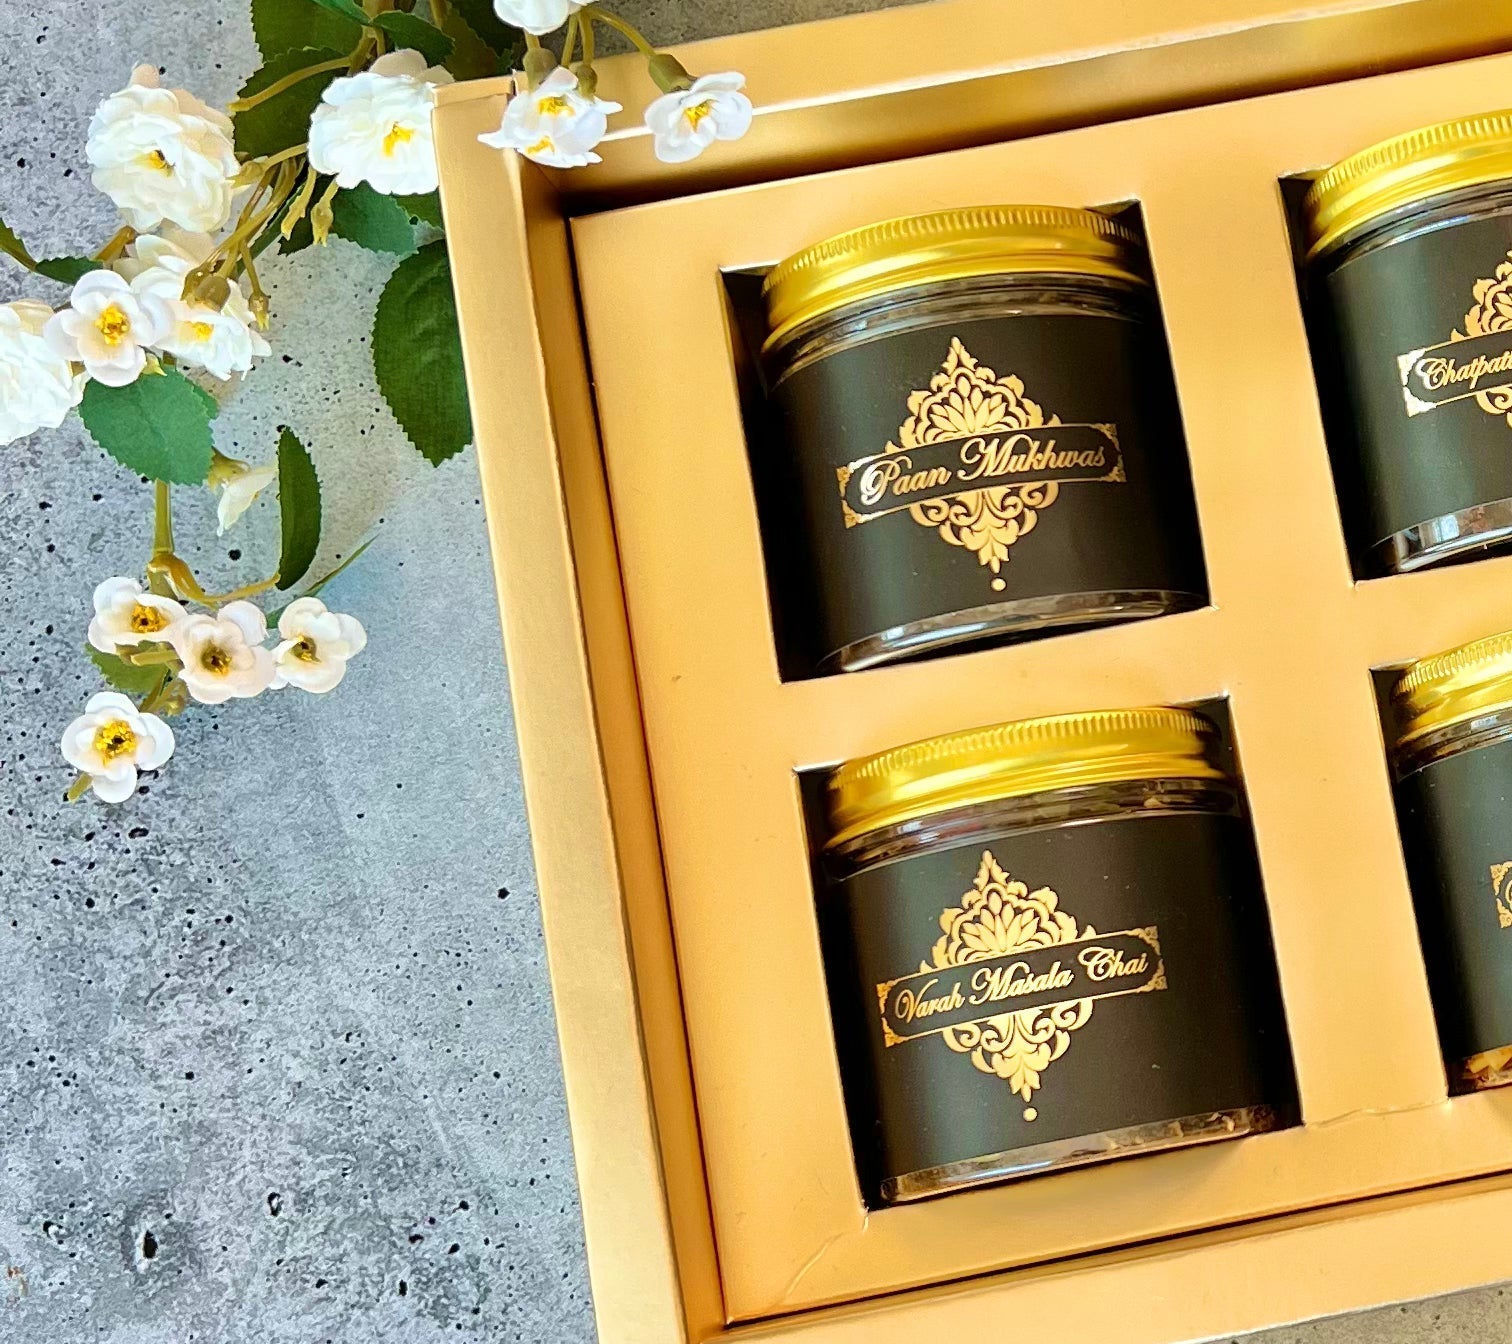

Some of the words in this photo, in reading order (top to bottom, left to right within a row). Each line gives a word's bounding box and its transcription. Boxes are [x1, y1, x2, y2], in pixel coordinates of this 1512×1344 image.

[860, 455, 952, 506] Paan
[957, 433, 1106, 482] Mukhwas
[894, 978, 966, 1024] Varah
[968, 960, 1075, 1006] Masala
[1077, 946, 1149, 982] Chai
